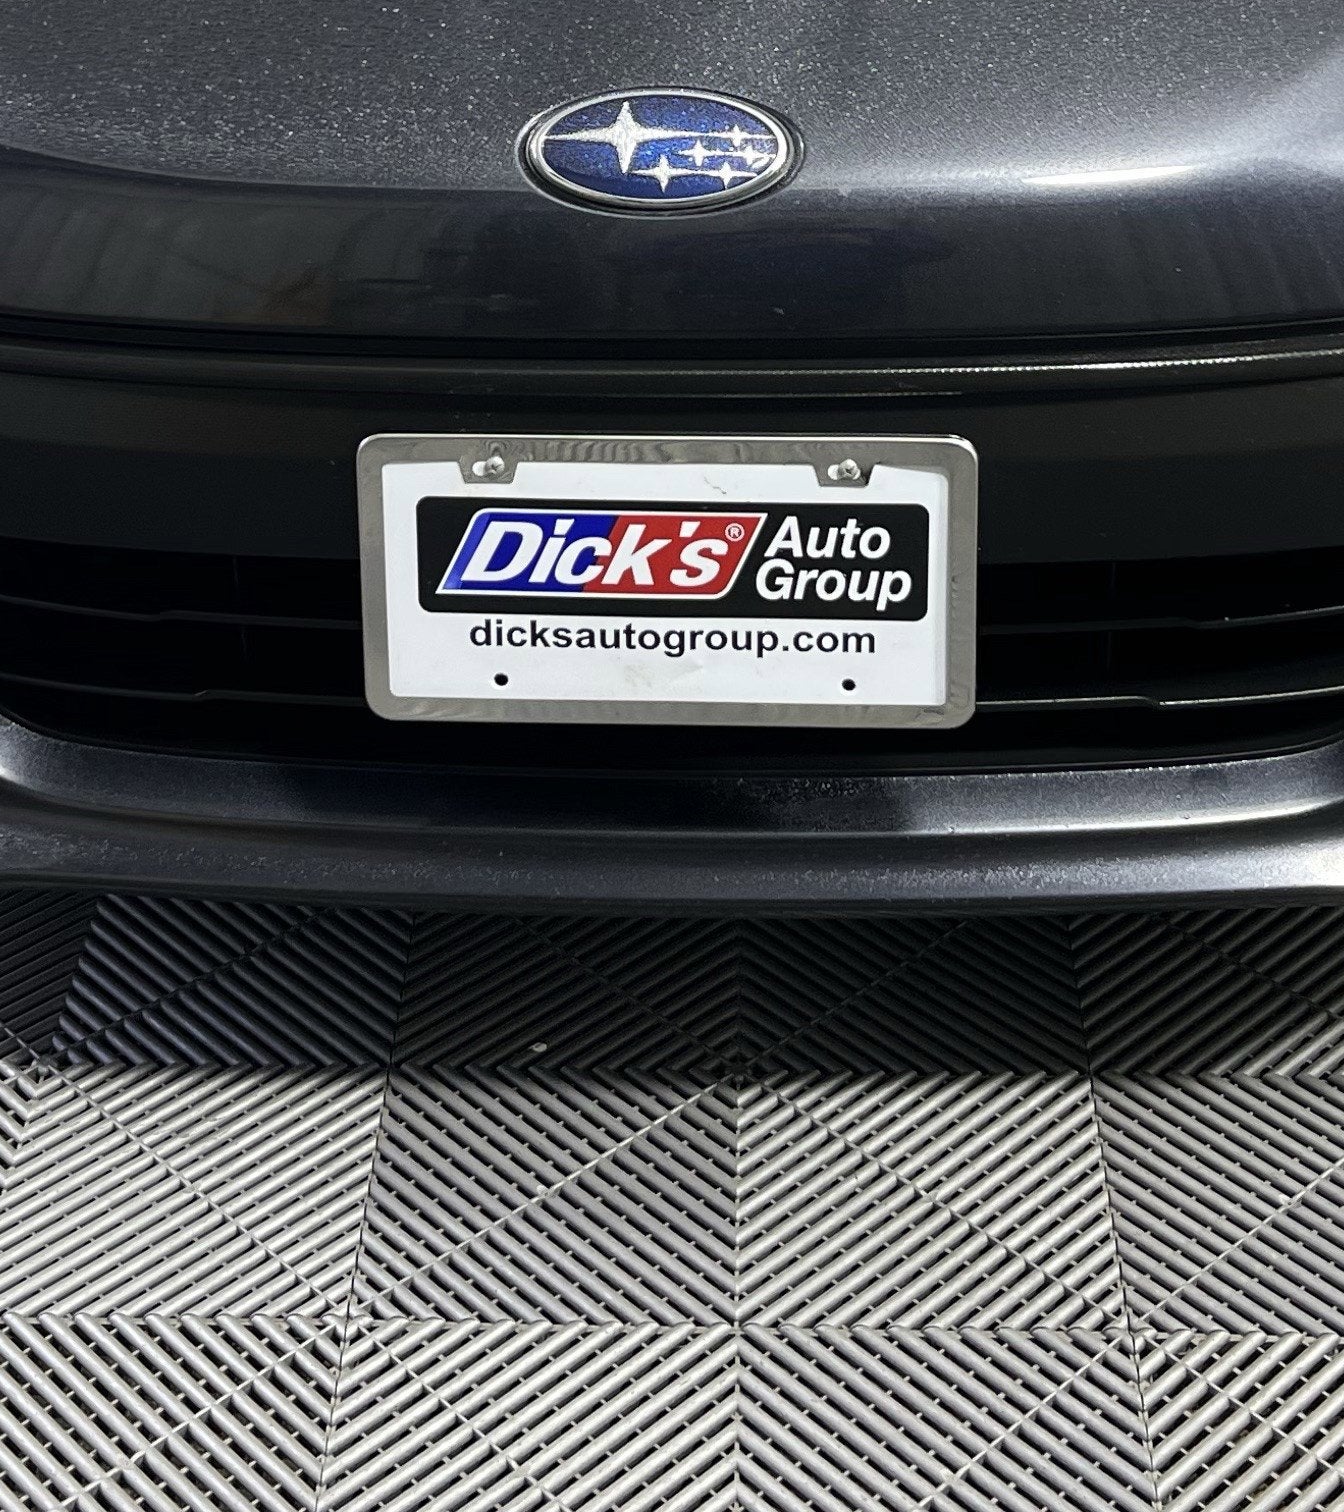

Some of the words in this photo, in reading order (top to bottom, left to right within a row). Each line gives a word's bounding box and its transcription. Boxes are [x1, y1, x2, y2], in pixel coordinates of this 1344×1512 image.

[763, 515, 891, 559] Auto
[755, 561, 913, 612] Group
[469, 619, 877, 659] dicksautogroup.com
